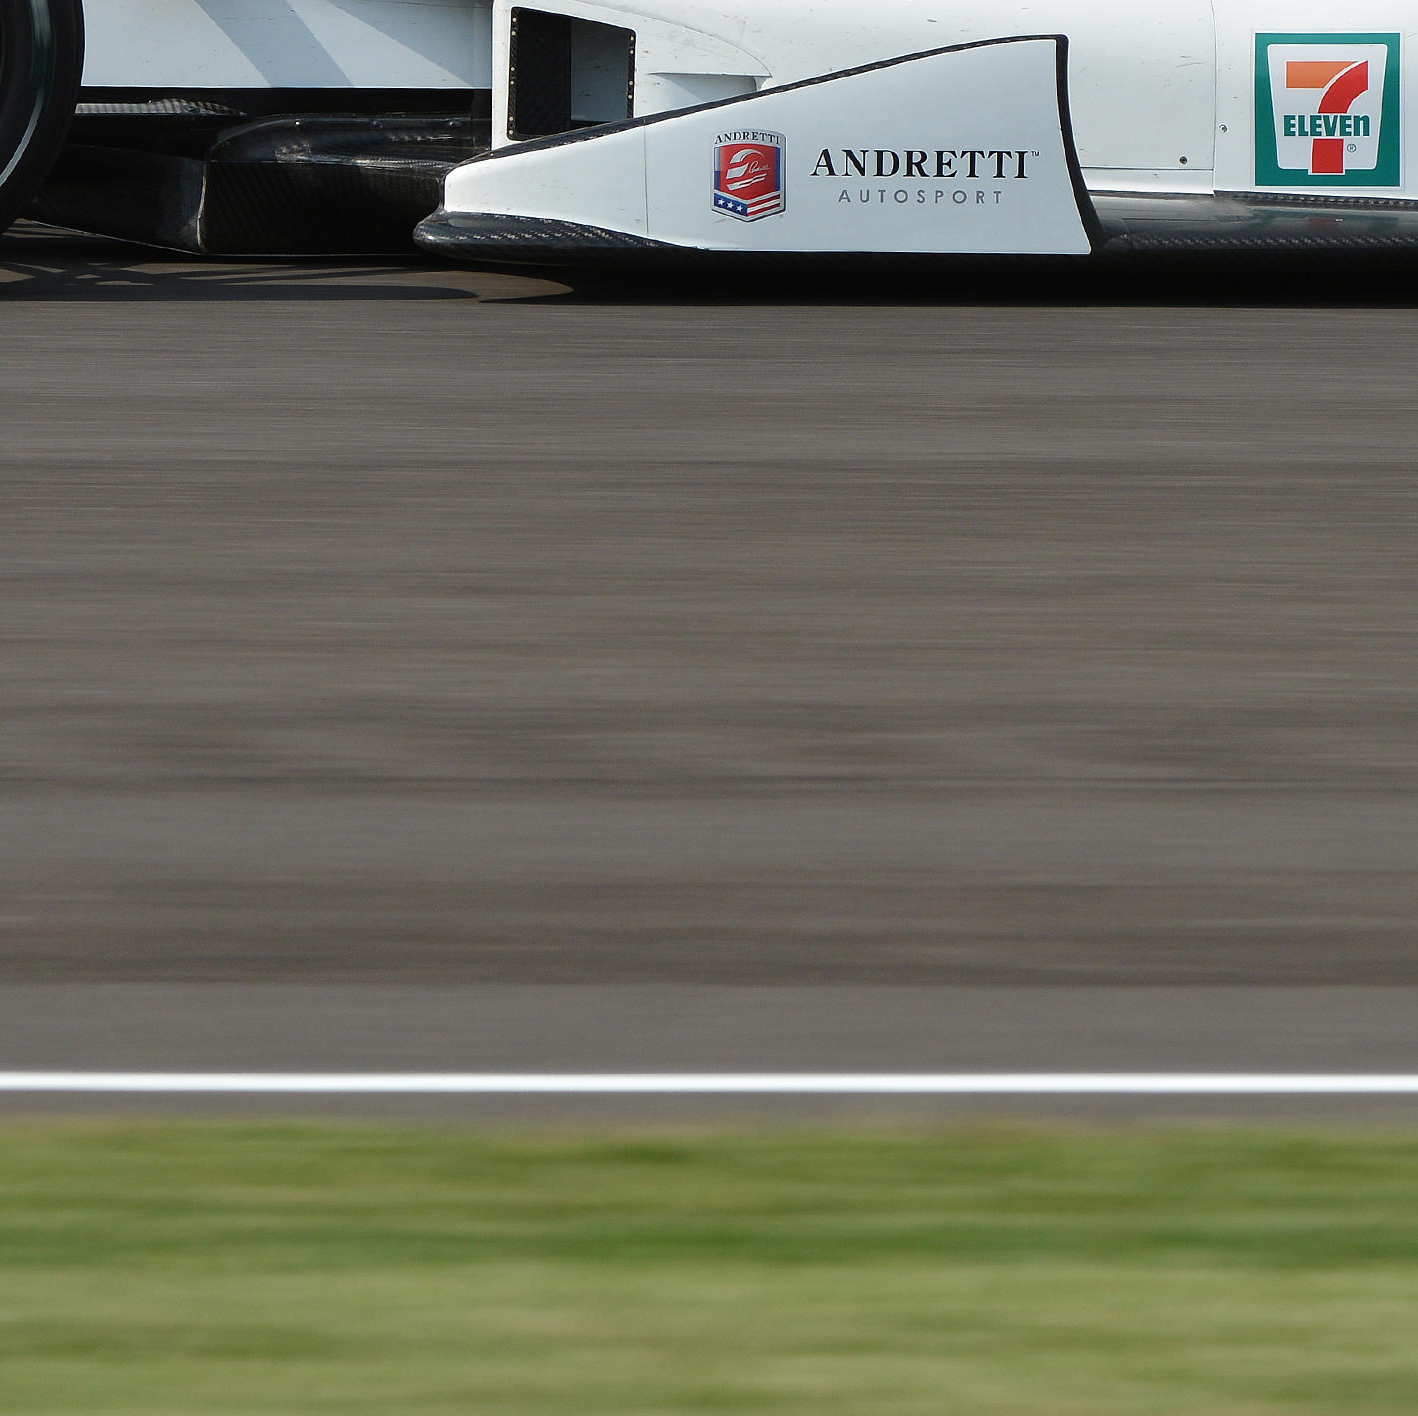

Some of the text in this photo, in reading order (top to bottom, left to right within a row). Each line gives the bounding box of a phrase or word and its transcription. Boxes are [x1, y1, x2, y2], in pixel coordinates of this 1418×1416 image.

[1286, 60, 1369, 174] 7
[714, 131, 781, 145] ANDRETTI
[810, 148, 1029, 179] ANDRETTI
[838, 189, 1002, 204] AUTOSPORT
